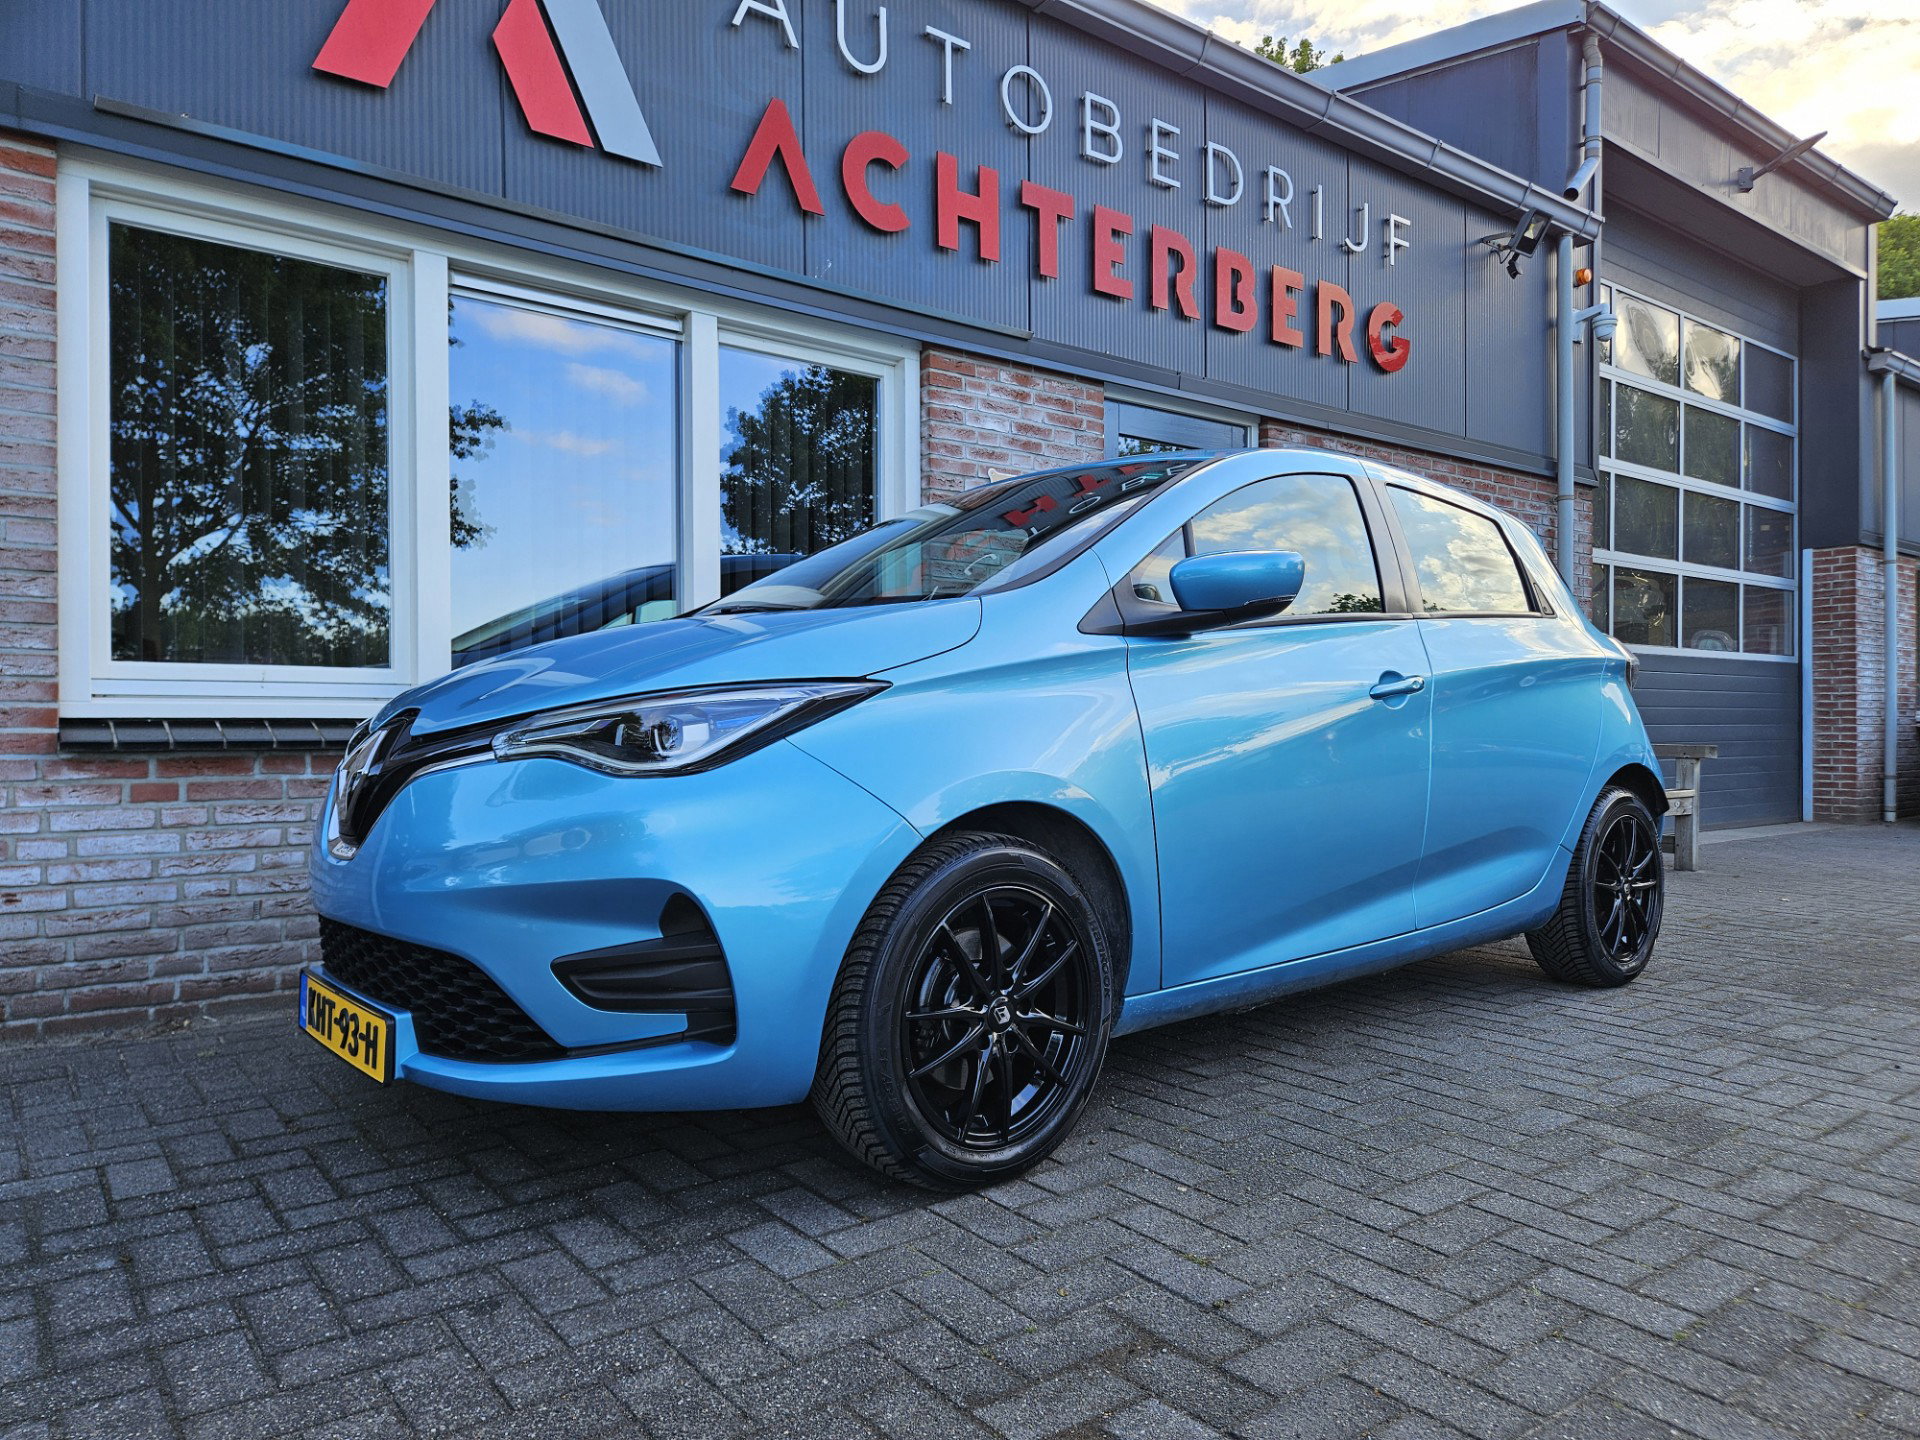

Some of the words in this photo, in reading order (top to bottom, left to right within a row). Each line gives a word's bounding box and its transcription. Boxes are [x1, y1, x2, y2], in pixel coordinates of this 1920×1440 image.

[730, 97, 1411, 373] ACHTERBERG
[732, 0, 1411, 266] AUTOBEDRIJF
[308, 986, 379, 1070] KHT-93-H
